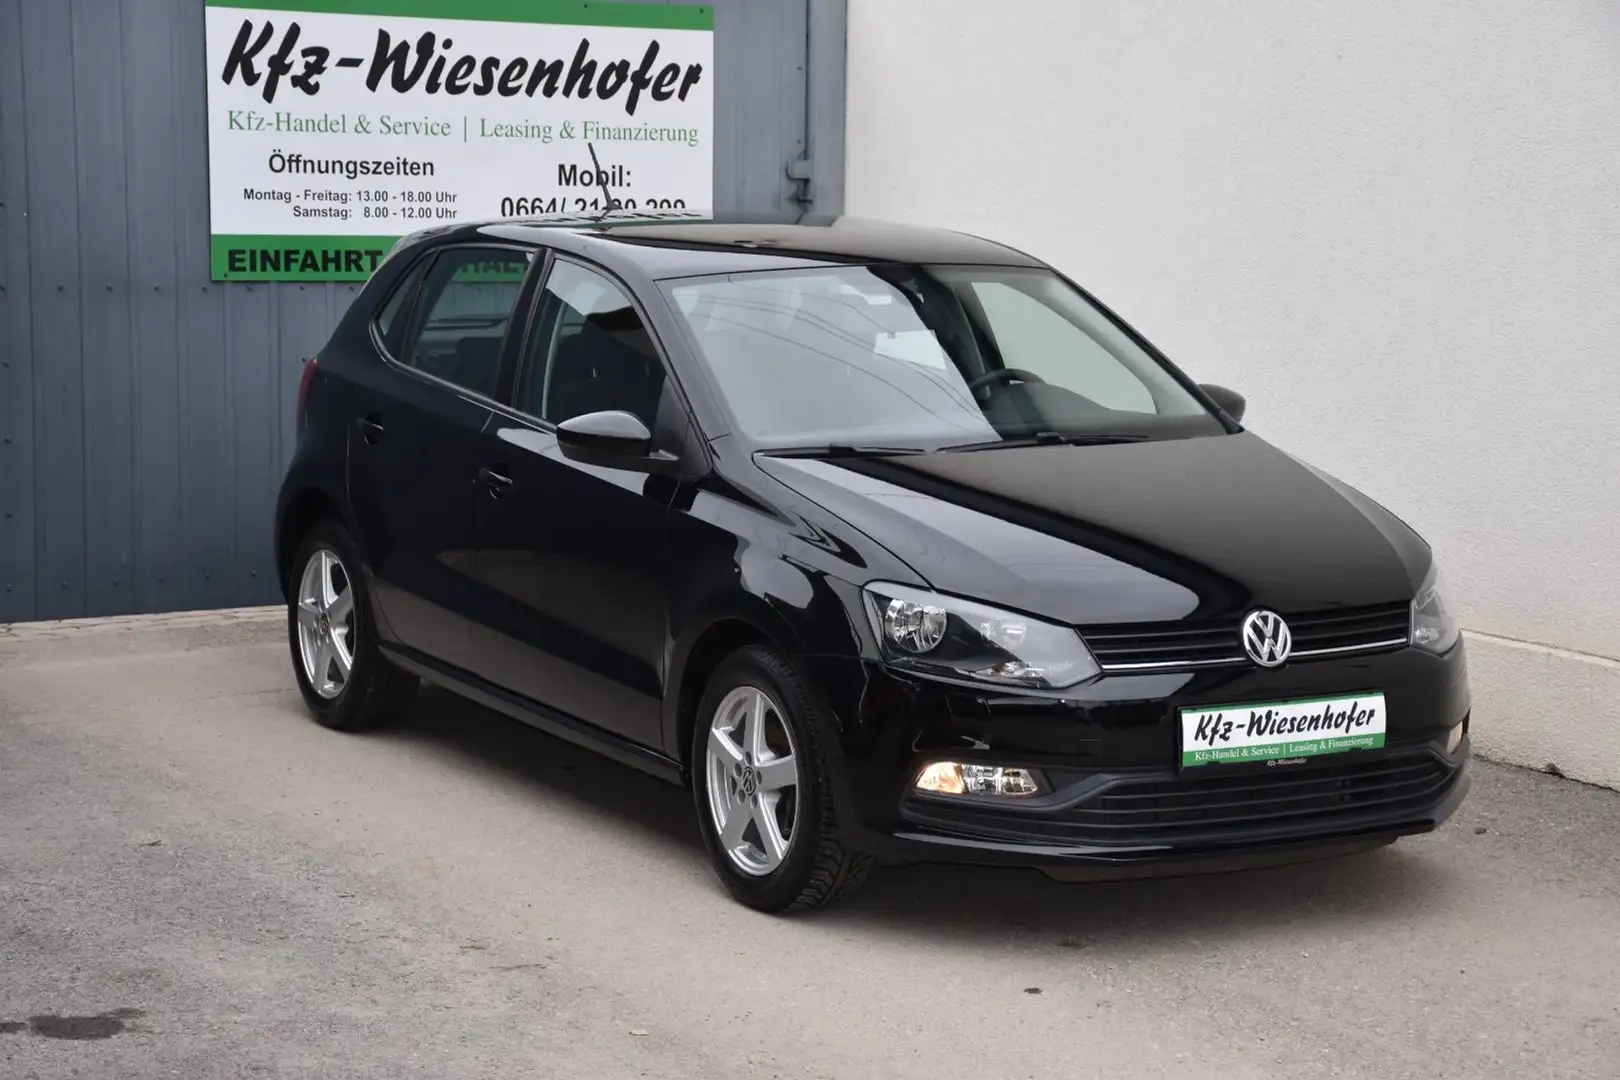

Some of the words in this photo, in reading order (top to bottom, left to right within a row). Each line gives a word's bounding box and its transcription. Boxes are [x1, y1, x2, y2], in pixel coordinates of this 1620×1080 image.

[222, 19, 703, 116] Kfz-Wiesenhofer
[228, 110, 346, 134] Kfz-Handel
[353, 115, 373, 135] &
[379, 115, 451, 136] Service
[480, 118, 553, 144] Leasing
[559, 120, 576, 140] &
[582, 121, 699, 147] Finanzierung
[268, 149, 434, 179] Öffnungszeiten
[558, 164, 631, 187] Mobil:
[243, 188, 292, 203] Montag
[303, 190, 352, 204] Freitag:
[356, 191, 389, 202] 13.00
[400, 191, 432, 203] 18.00
[435, 191, 458, 203] Uhr
[292, 205, 352, 220] Samstag:
[363, 207, 389, 218] 8.00
[400, 207, 433, 219] 12.00
[435, 207, 458, 219] Uhr
[228, 250, 383, 273] EINFAHRT
[1194, 702, 1376, 747] Kfz-Wiesenhofer
[1195, 749, 1240, 761] Kfz-Handel
[1241, 748, 1249, 757] &
[1251, 746, 1280, 756] Service
[1289, 743, 1318, 753] Leasing
[1319, 741, 1327, 750] &
[1328, 737, 1374, 749] Finanzierung
